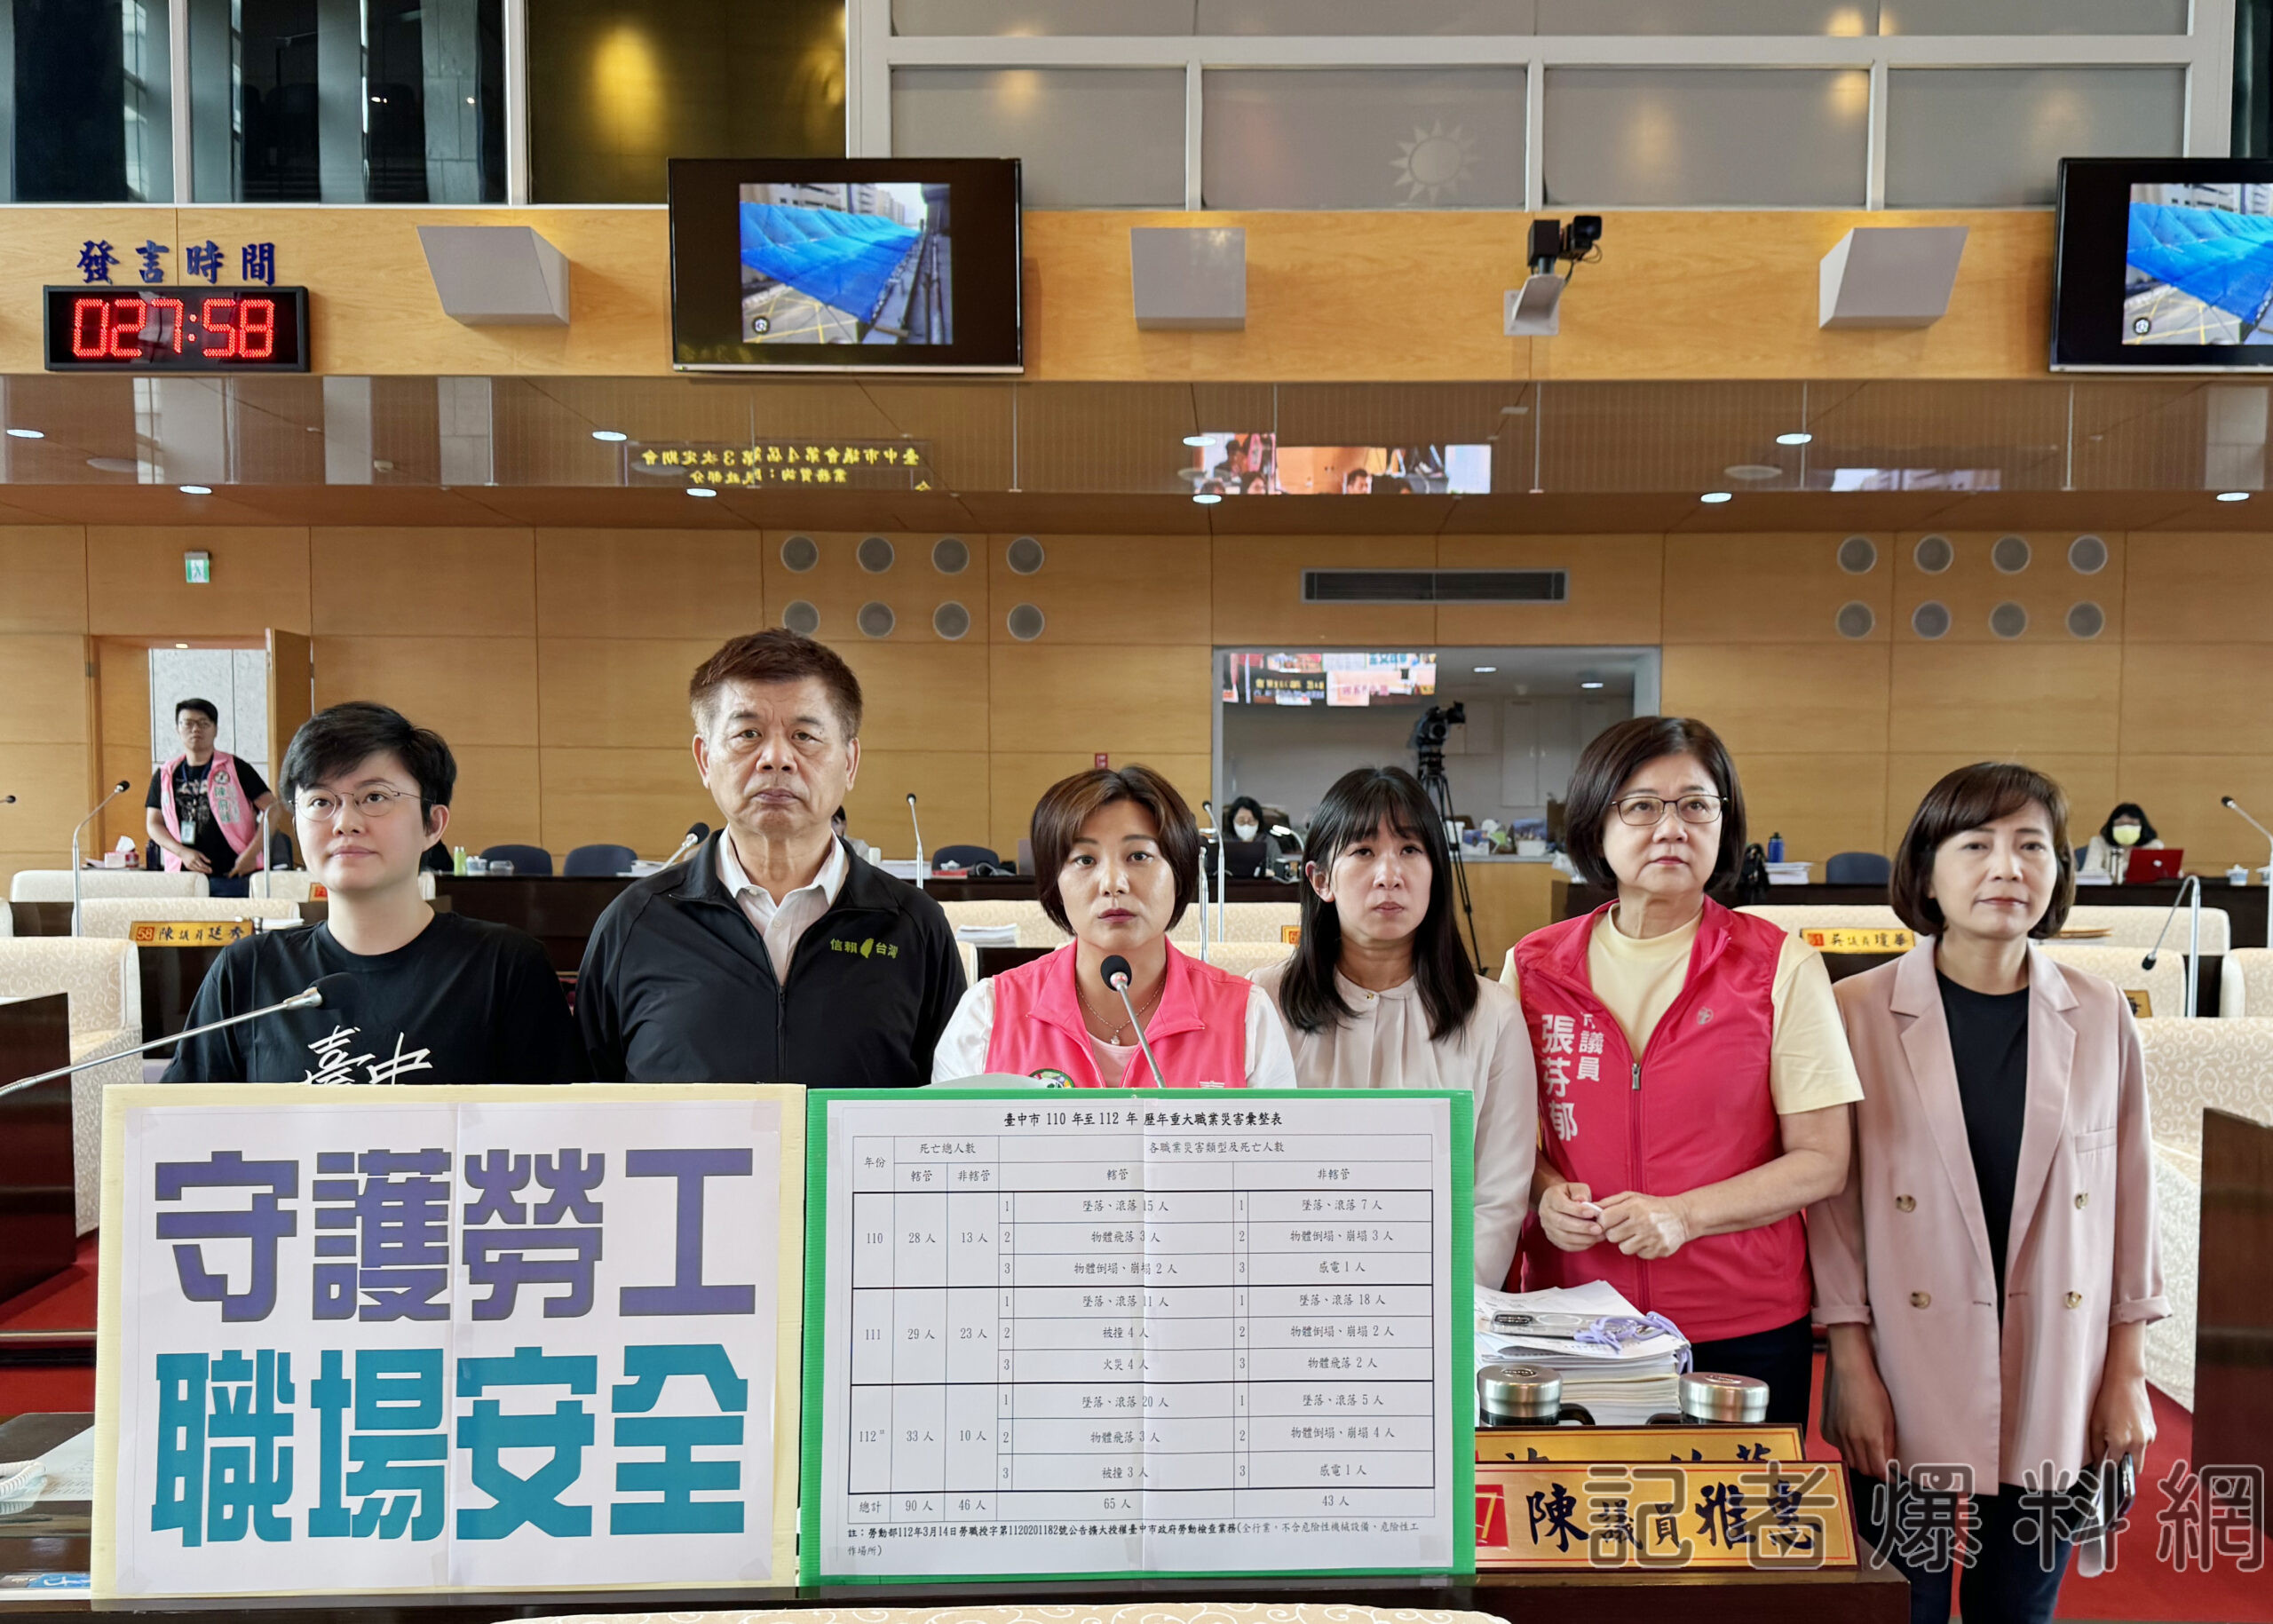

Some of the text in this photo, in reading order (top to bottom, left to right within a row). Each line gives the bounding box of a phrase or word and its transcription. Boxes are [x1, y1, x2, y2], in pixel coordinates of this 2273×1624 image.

[77, 240, 275, 285] 發言時間
[73, 298, 275, 357] 027:58
[137, 928, 154, 941] 58
[1541, 1013, 1579, 1141] 張芬郁
[1004, 1113, 1041, 1127] 臺中市
[1047, 1113, 1065, 1125] 110
[1072, 1112, 1095, 1126] 年至
[1100, 1112, 1119, 1124] 112
[1126, 1112, 1138, 1126] 年
[865, 1156, 886, 1168] 年份
[911, 1170, 932, 1182] 轄管
[958, 1169, 990, 1182] 非轄管
[1107, 1168, 1129, 1180] 轄管
[1318, 1168, 1350, 1180] 非轄管
[154, 1147, 756, 1322] 守護勞工
[867, 1233, 883, 1243] 110
[909, 1232, 921, 1243] 28
[962, 1232, 972, 1243] 13
[1319, 1261, 1339, 1273] 感電
[1360, 1294, 1370, 1305] 18
[867, 1329, 880, 1340] 111
[908, 1328, 919, 1340] 29
[961, 1328, 971, 1339] 23
[1103, 1327, 1123, 1338] 被撞
[1104, 1359, 1123, 1370] 火災
[907, 1430, 918, 1441] 33
[961, 1430, 970, 1441] 10
[151, 1343, 748, 1548] 職場安全
[1102, 1467, 1122, 1478] 被撞
[1320, 1464, 1341, 1477] 感電
[906, 1500, 916, 1511] 90
[959, 1499, 970, 1510] 46
[1105, 1498, 1115, 1509] 65
[1322, 1495, 1334, 1506] 43
[859, 1501, 881, 1513] 總計
